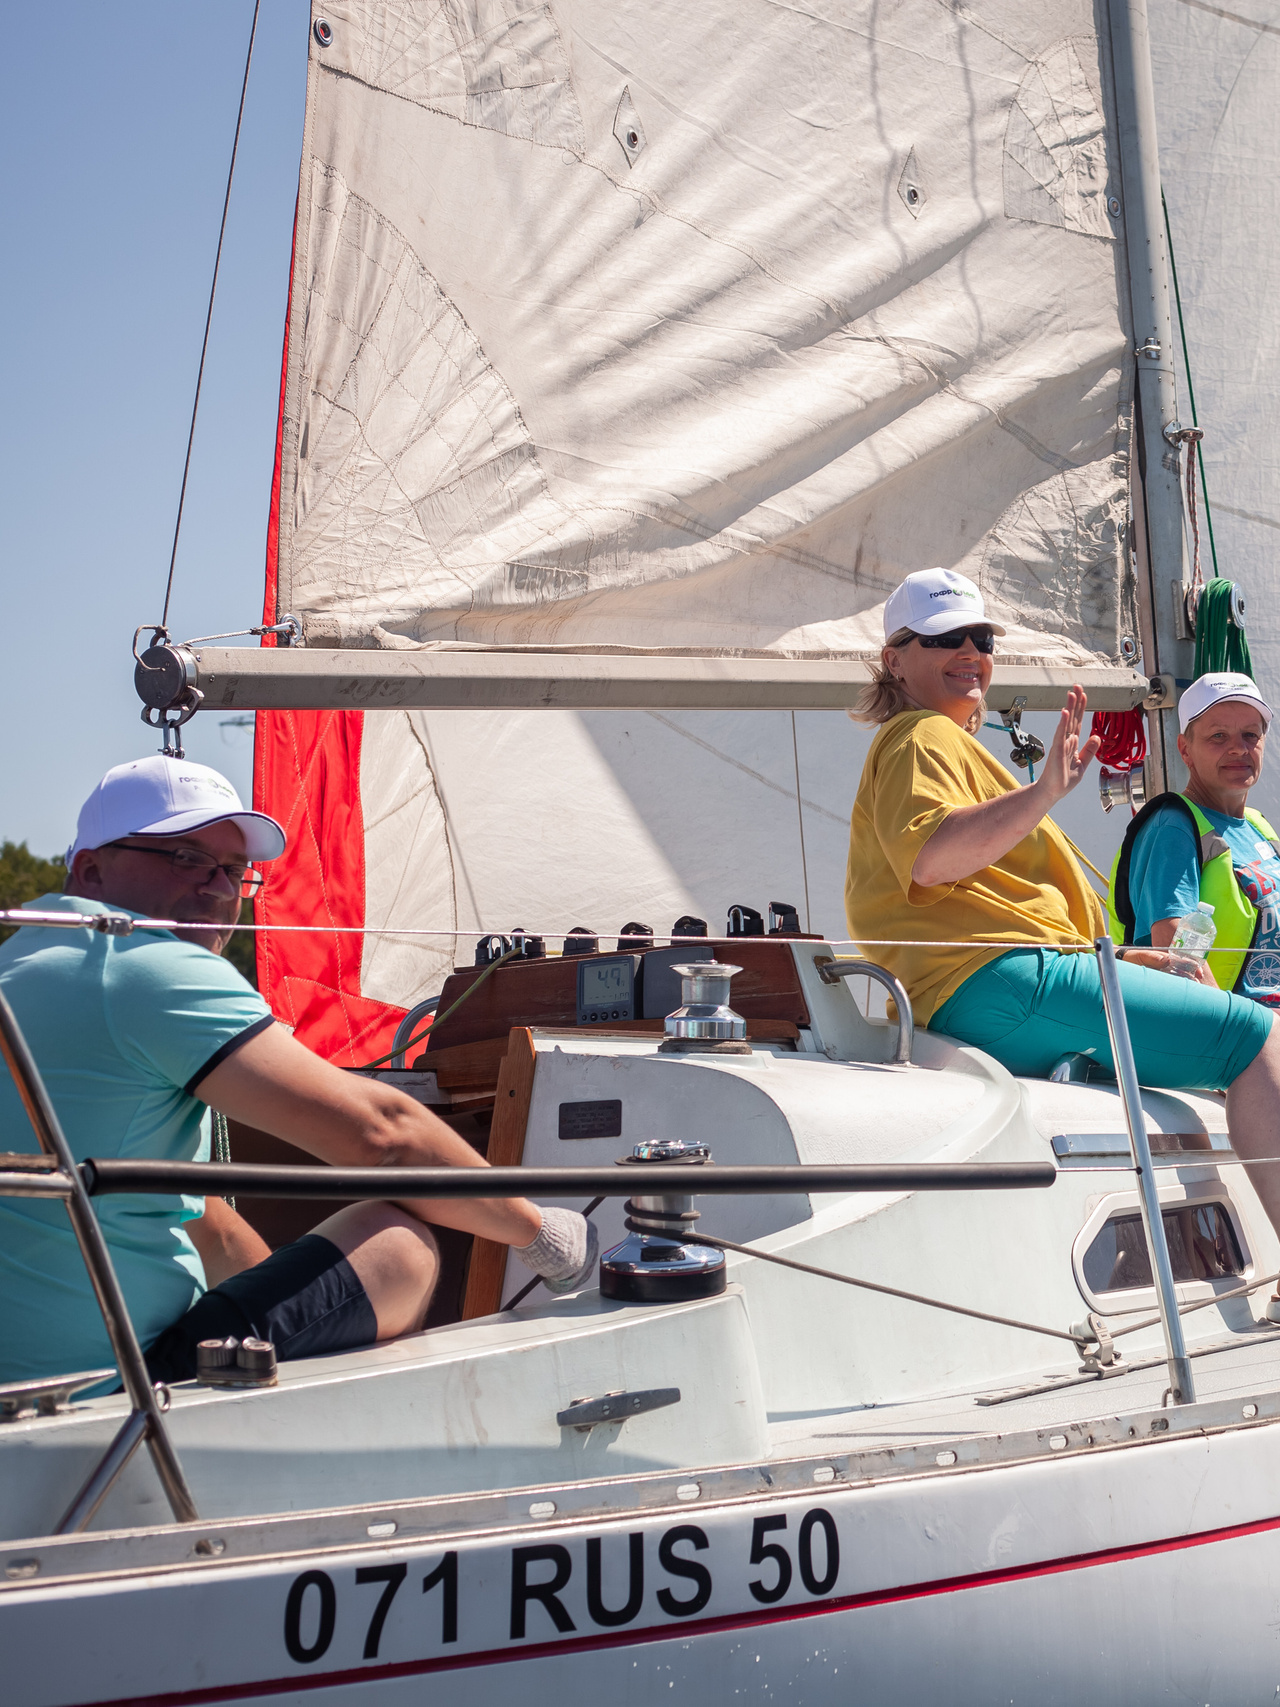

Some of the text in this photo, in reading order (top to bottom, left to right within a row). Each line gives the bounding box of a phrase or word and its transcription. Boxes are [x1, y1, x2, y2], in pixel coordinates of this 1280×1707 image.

[283, 1508, 840, 1665] 071 RUS 50
